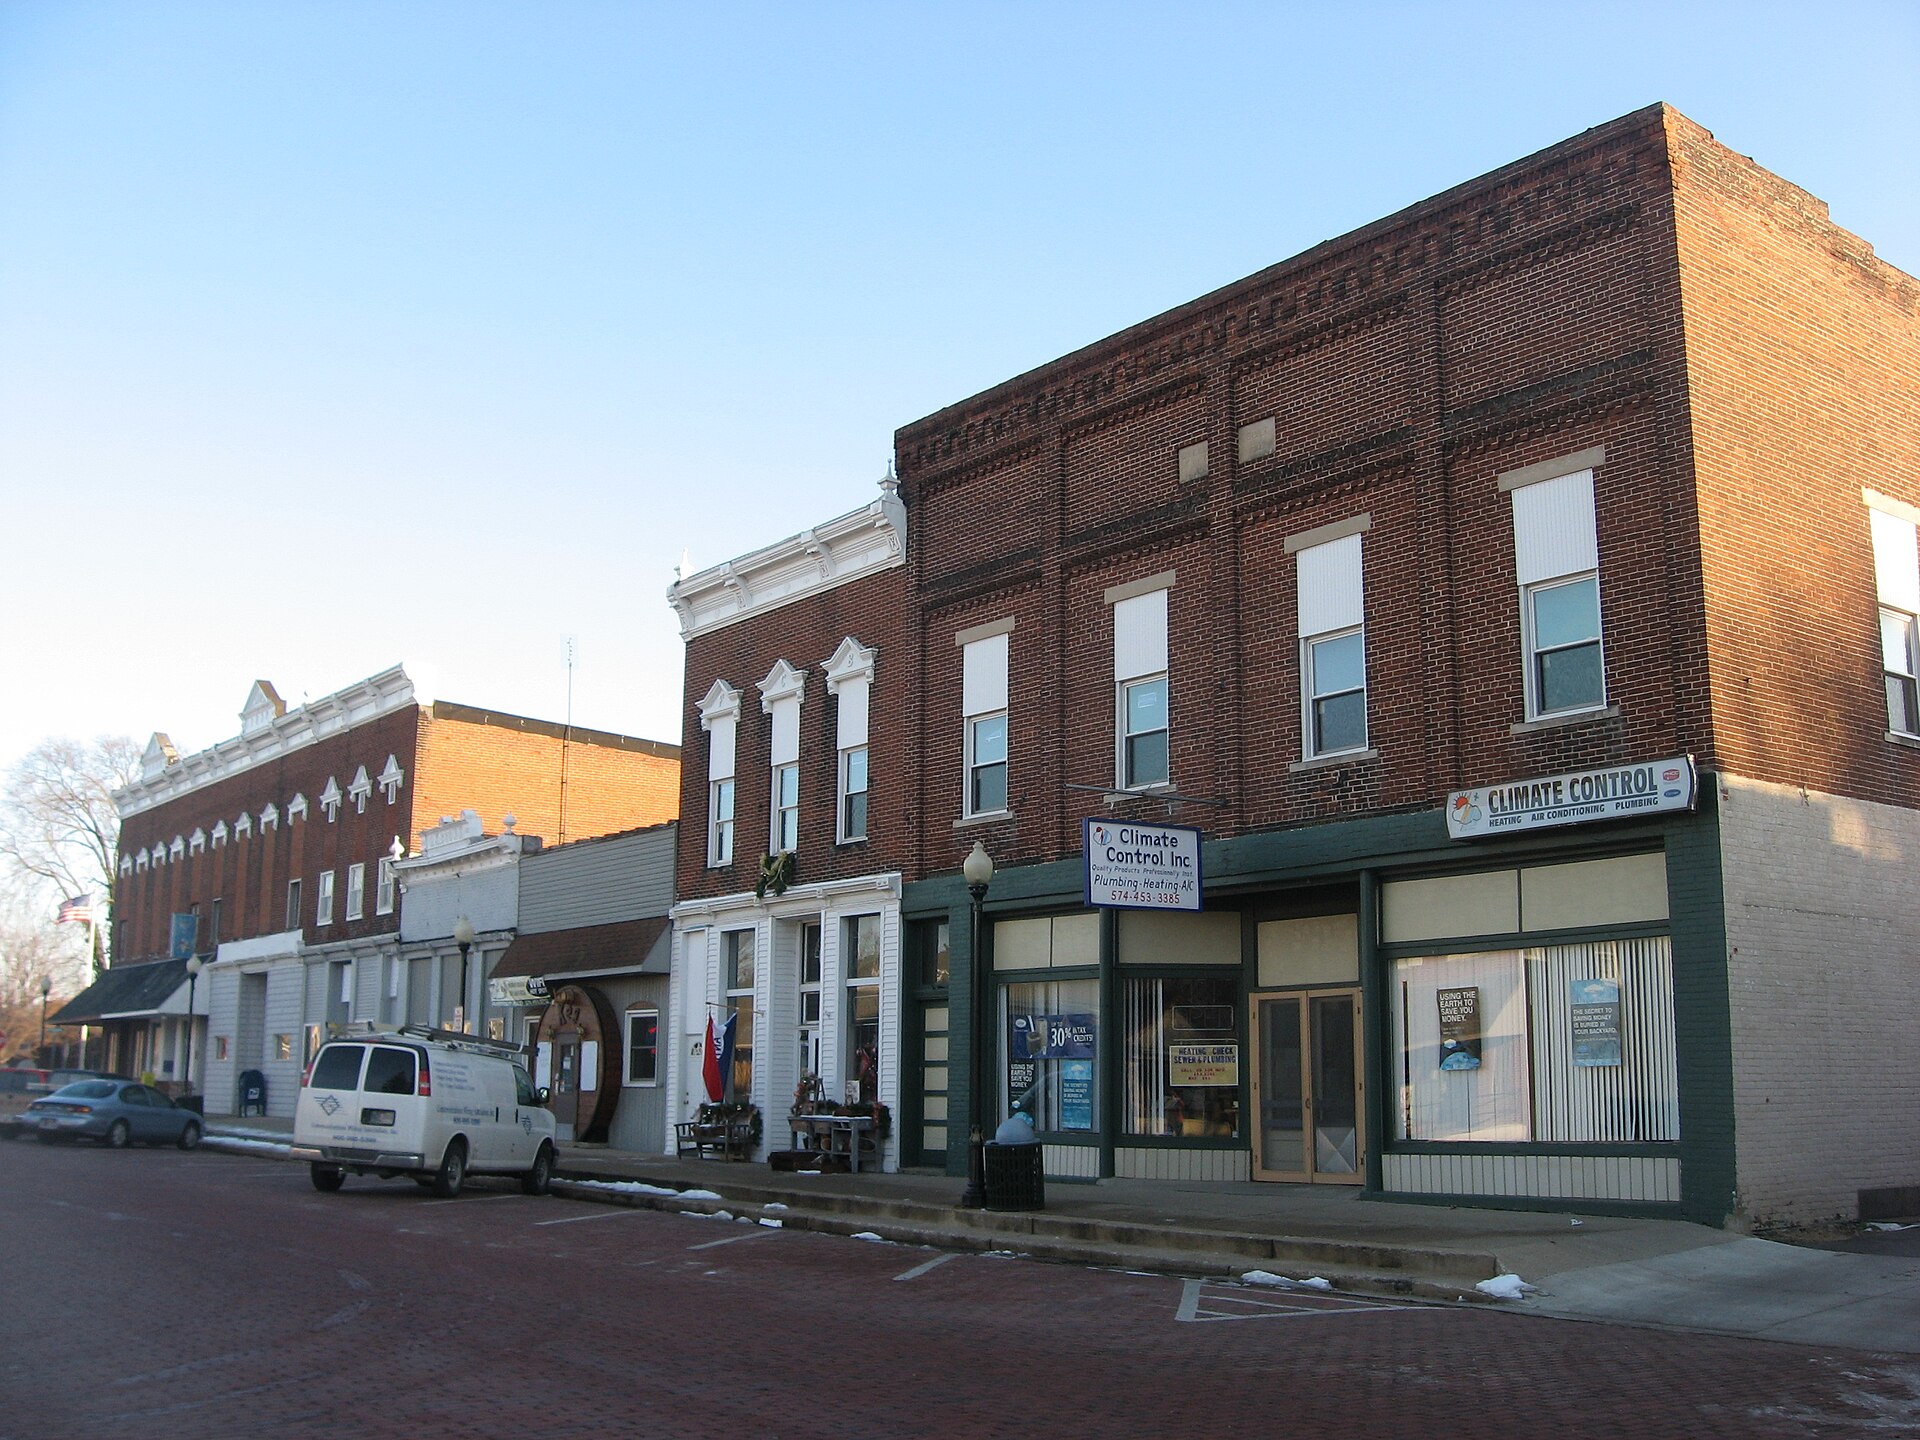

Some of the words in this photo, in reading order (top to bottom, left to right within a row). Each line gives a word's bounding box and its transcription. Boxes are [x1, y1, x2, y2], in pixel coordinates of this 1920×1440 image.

[1488, 781, 1563, 814] CLIMATE
[1569, 767, 1658, 802] CONTROL
[1489, 815, 1522, 828] HEATING
[1531, 812, 1545, 822] AIR
[1546, 804, 1605, 820] CONDITIONING
[1615, 797, 1659, 811] PLUMBING
[1120, 828, 1178, 848] Climate
[1171, 851, 1192, 868] Inc.
[1091, 864, 1112, 873] Quality
[1114, 864, 1140, 874] Products
[1111, 890, 1180, 904] 574-453-3385
[1439, 992, 1461, 1001] USING
[1462, 991, 1476, 999] THE
[1440, 999, 1463, 1008] EARTH
[1441, 1007, 1458, 1015] SAVE
[1459, 1006, 1473, 1014] YOU
[1212, 1046, 1234, 1055] CHECK
[1203, 1055, 1236, 1064] PLUMBING
